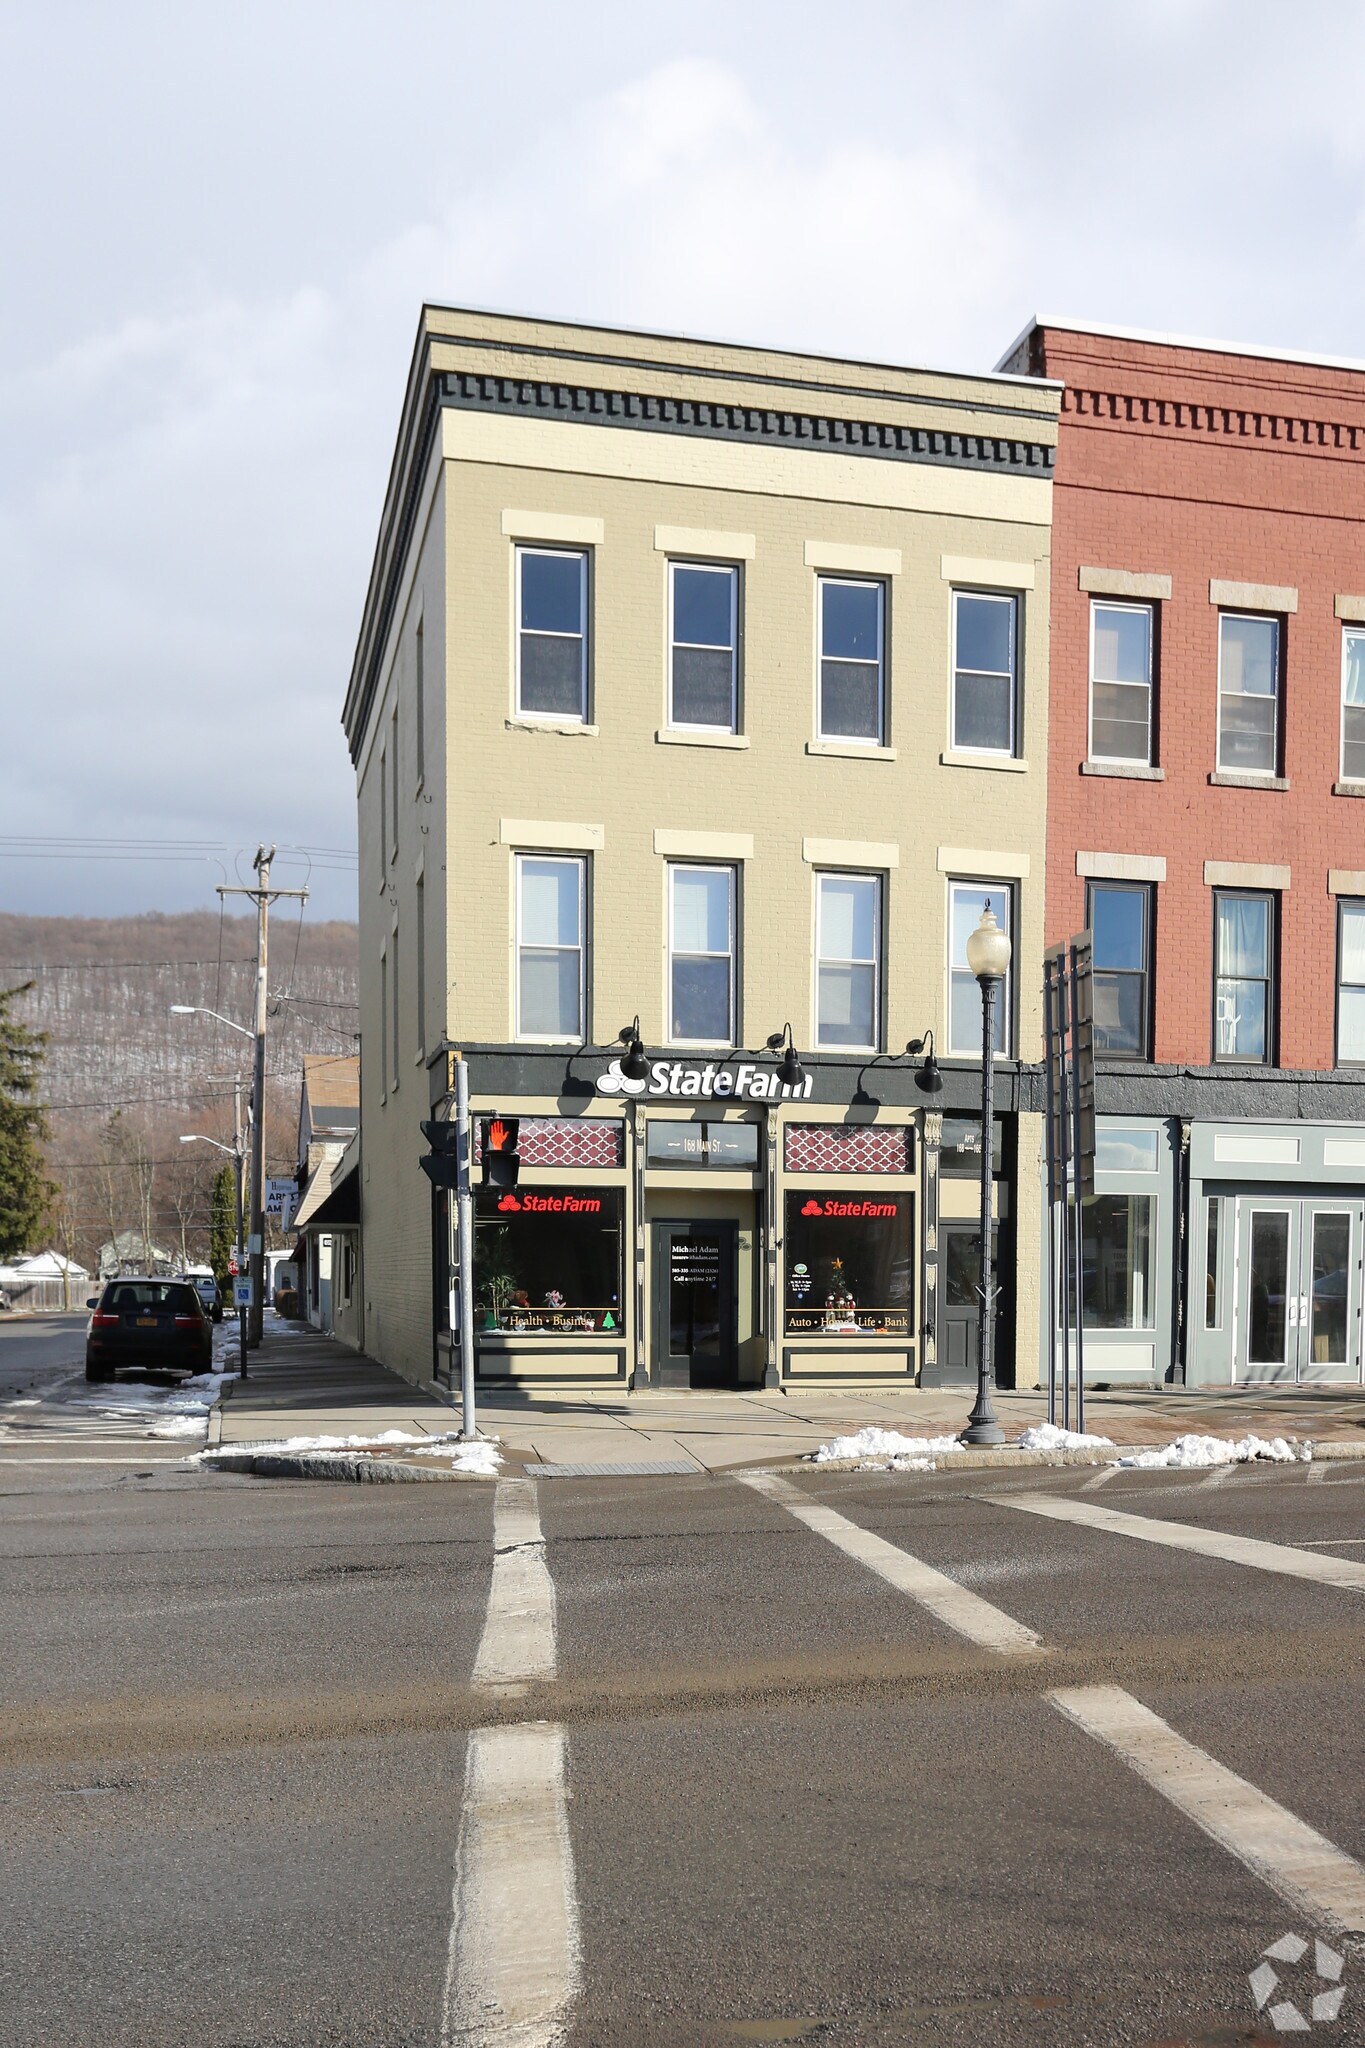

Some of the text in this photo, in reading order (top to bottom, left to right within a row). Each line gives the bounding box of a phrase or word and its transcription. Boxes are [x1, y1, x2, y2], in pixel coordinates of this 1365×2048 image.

[684, 1138, 696, 1152] 168
[269, 1193, 295, 1201] ARS
[672, 1245, 698, 1253] Michael
[509, 1315, 596, 1326] Health Business
[788, 1317, 908, 1327] Auto Home Life Bank
